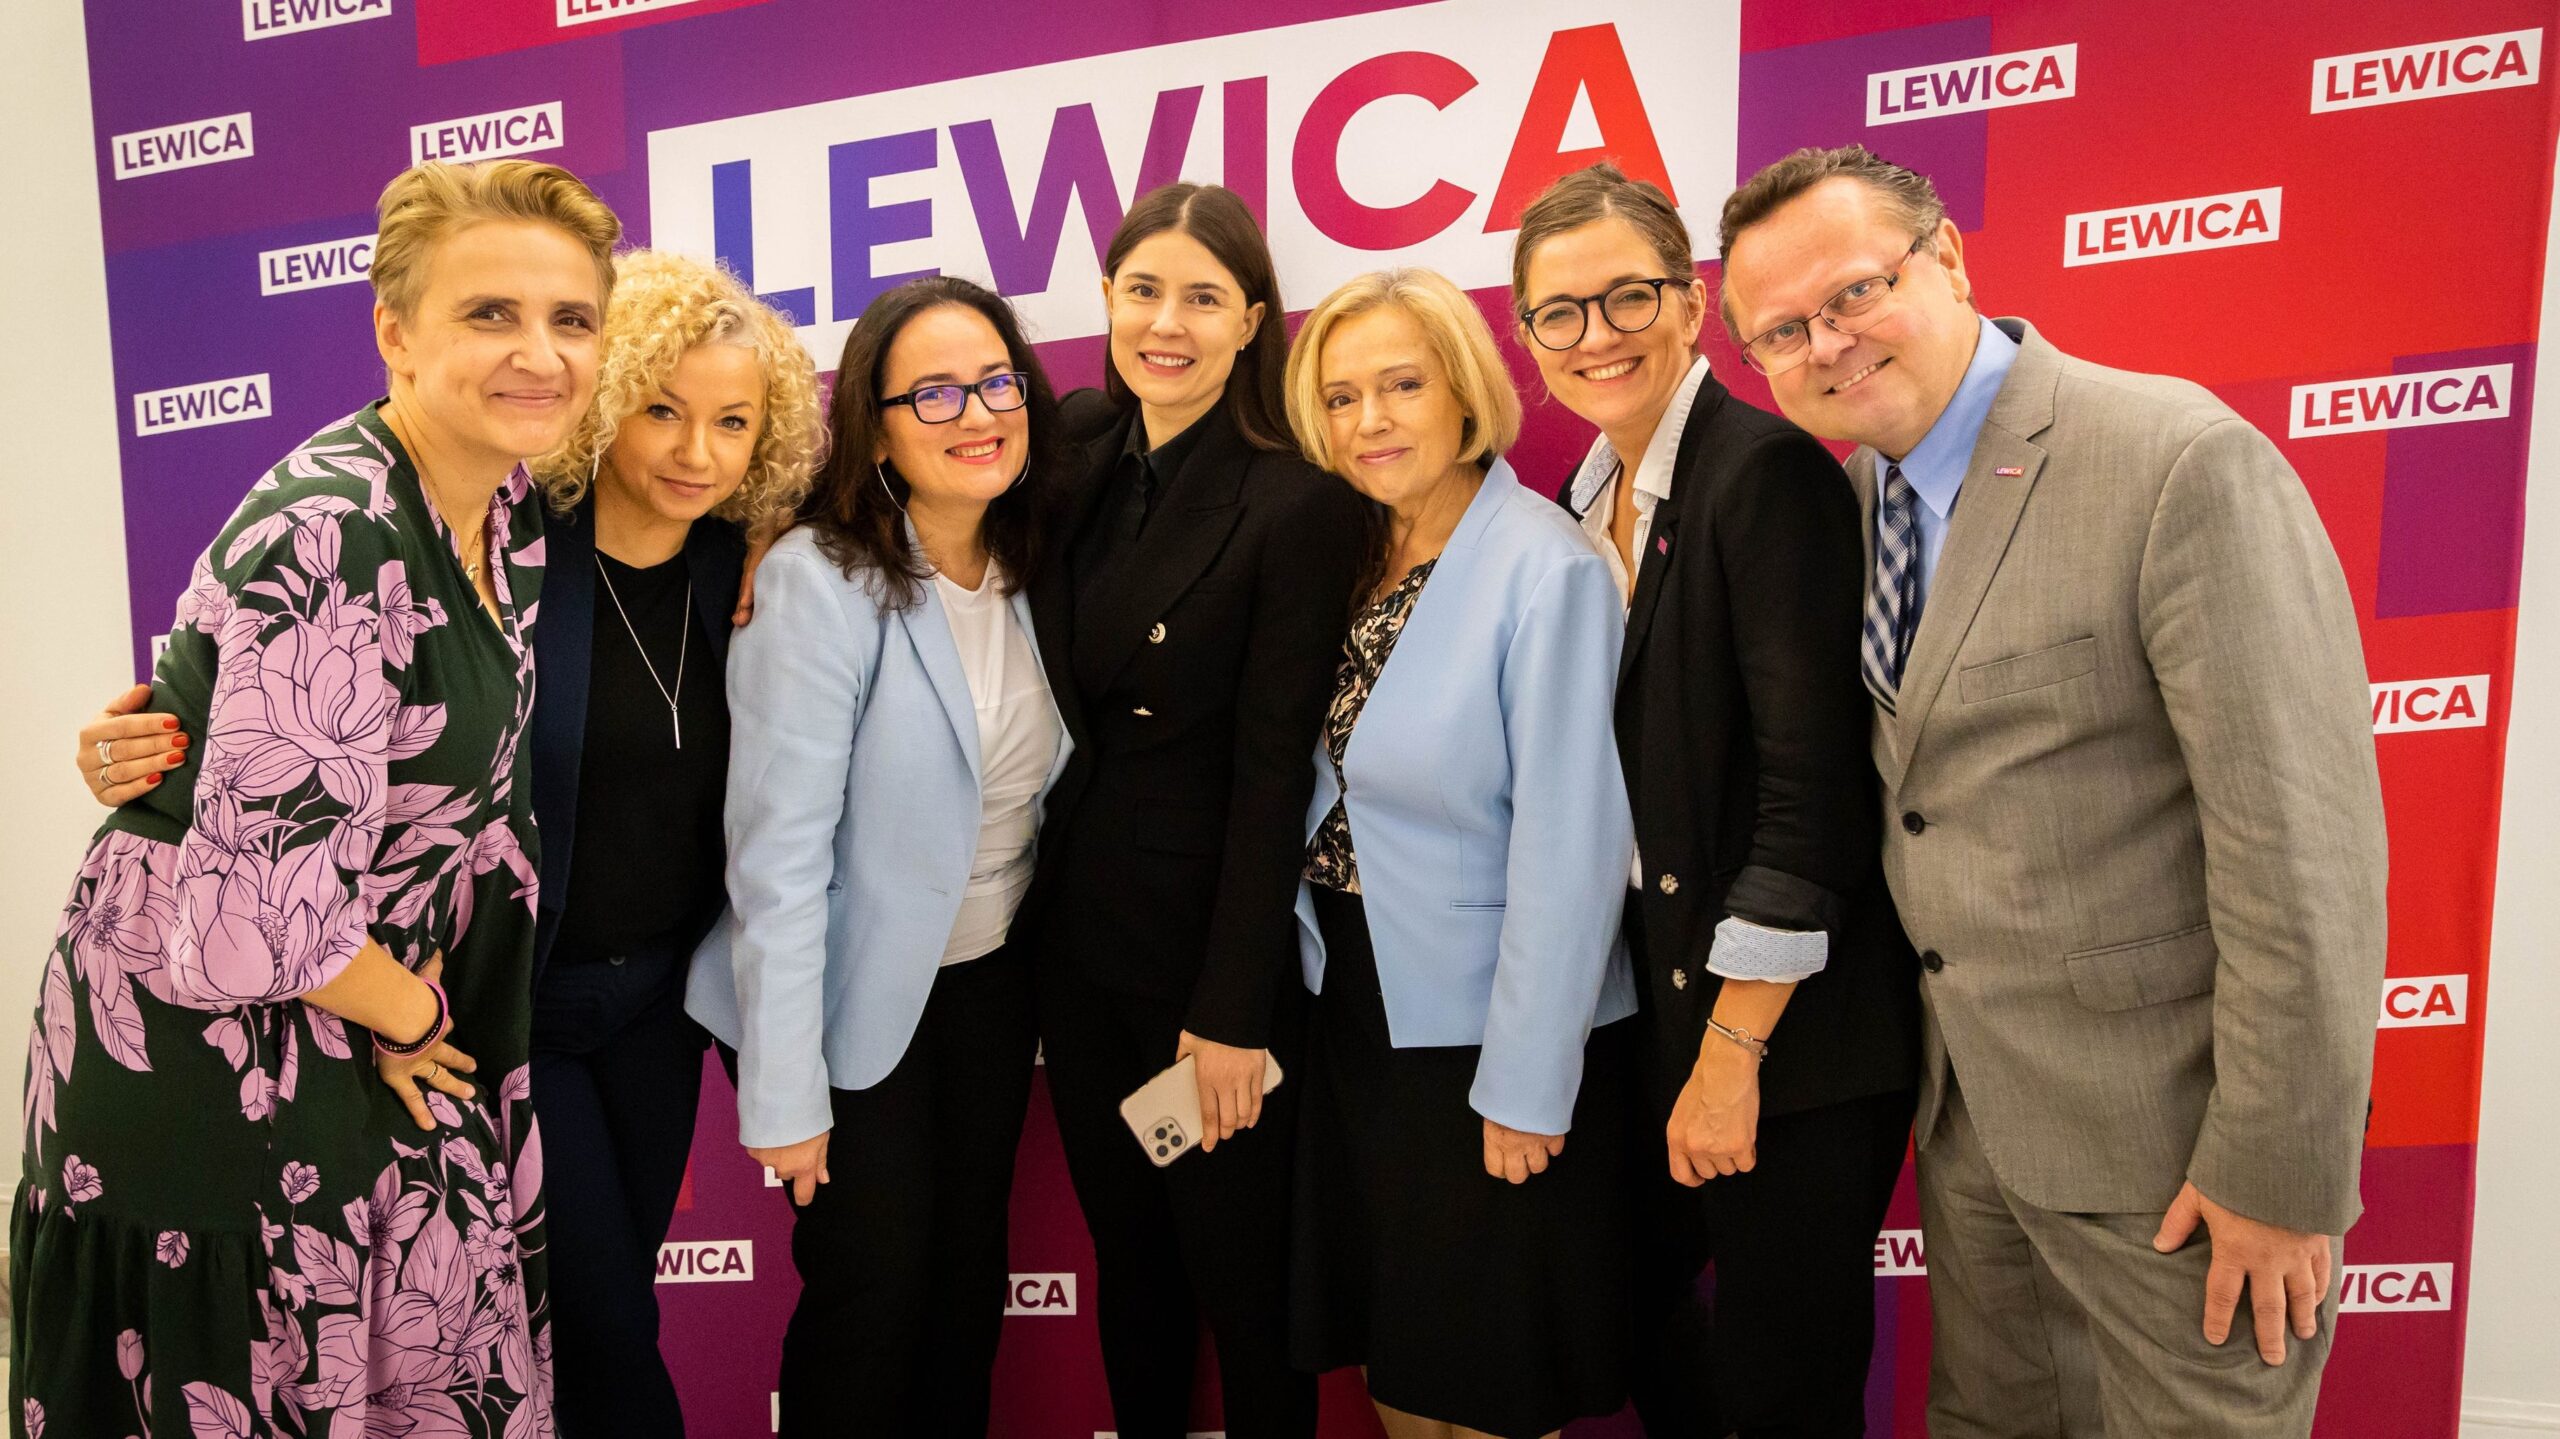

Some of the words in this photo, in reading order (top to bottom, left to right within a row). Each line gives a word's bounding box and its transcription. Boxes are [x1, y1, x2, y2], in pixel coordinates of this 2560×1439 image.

[1879, 55, 2066, 116] LEWICA
[2325, 39, 2529, 103] LEWICA
[121, 122, 246, 171] LEWICA
[421, 111, 555, 161] LEWICA
[712, 22, 1681, 326] LEWICA
[2077, 198, 2269, 257] LEWICA
[269, 243, 372, 287] LEWIC
[144, 382, 264, 428] LEWICA
[2303, 374, 2500, 429] LEWICA
[2372, 684, 2477, 726] ICA
[657, 1247, 746, 1276] WICA
[1005, 1279, 1069, 1309] ICA
[2339, 1271, 2441, 1305] ICA
